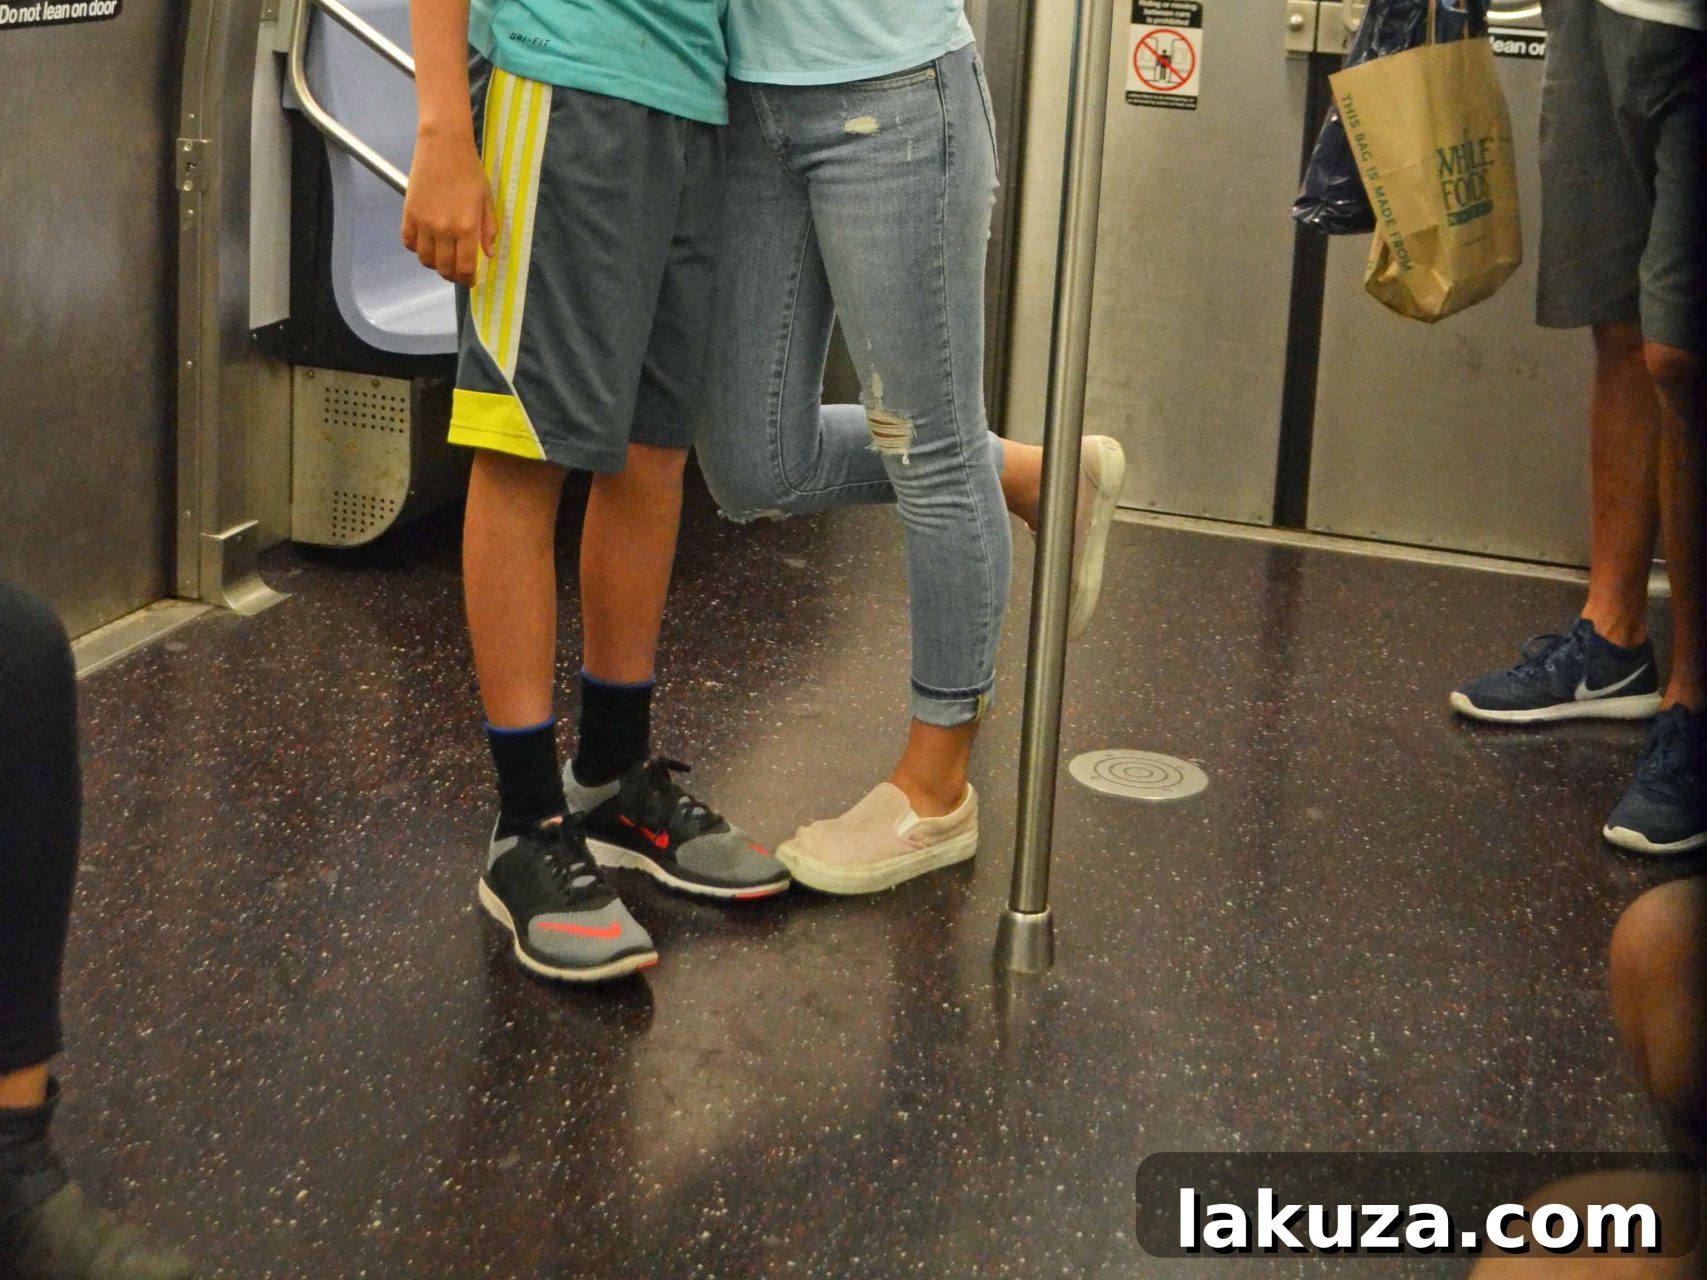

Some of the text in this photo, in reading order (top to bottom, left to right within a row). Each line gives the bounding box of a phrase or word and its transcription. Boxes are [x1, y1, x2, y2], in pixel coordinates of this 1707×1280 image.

[0, 4, 18, 25] Do
[18, 2, 41, 22] not
[43, 1, 70, 20] lean
[71, 2, 87, 18] on
[509, 31, 552, 48] DRI-FIT
[1342, 94, 1361, 129] THIS
[1355, 133, 1373, 162] BAG
[1366, 166, 1380, 181] IS
[1373, 185, 1398, 228] MADE
